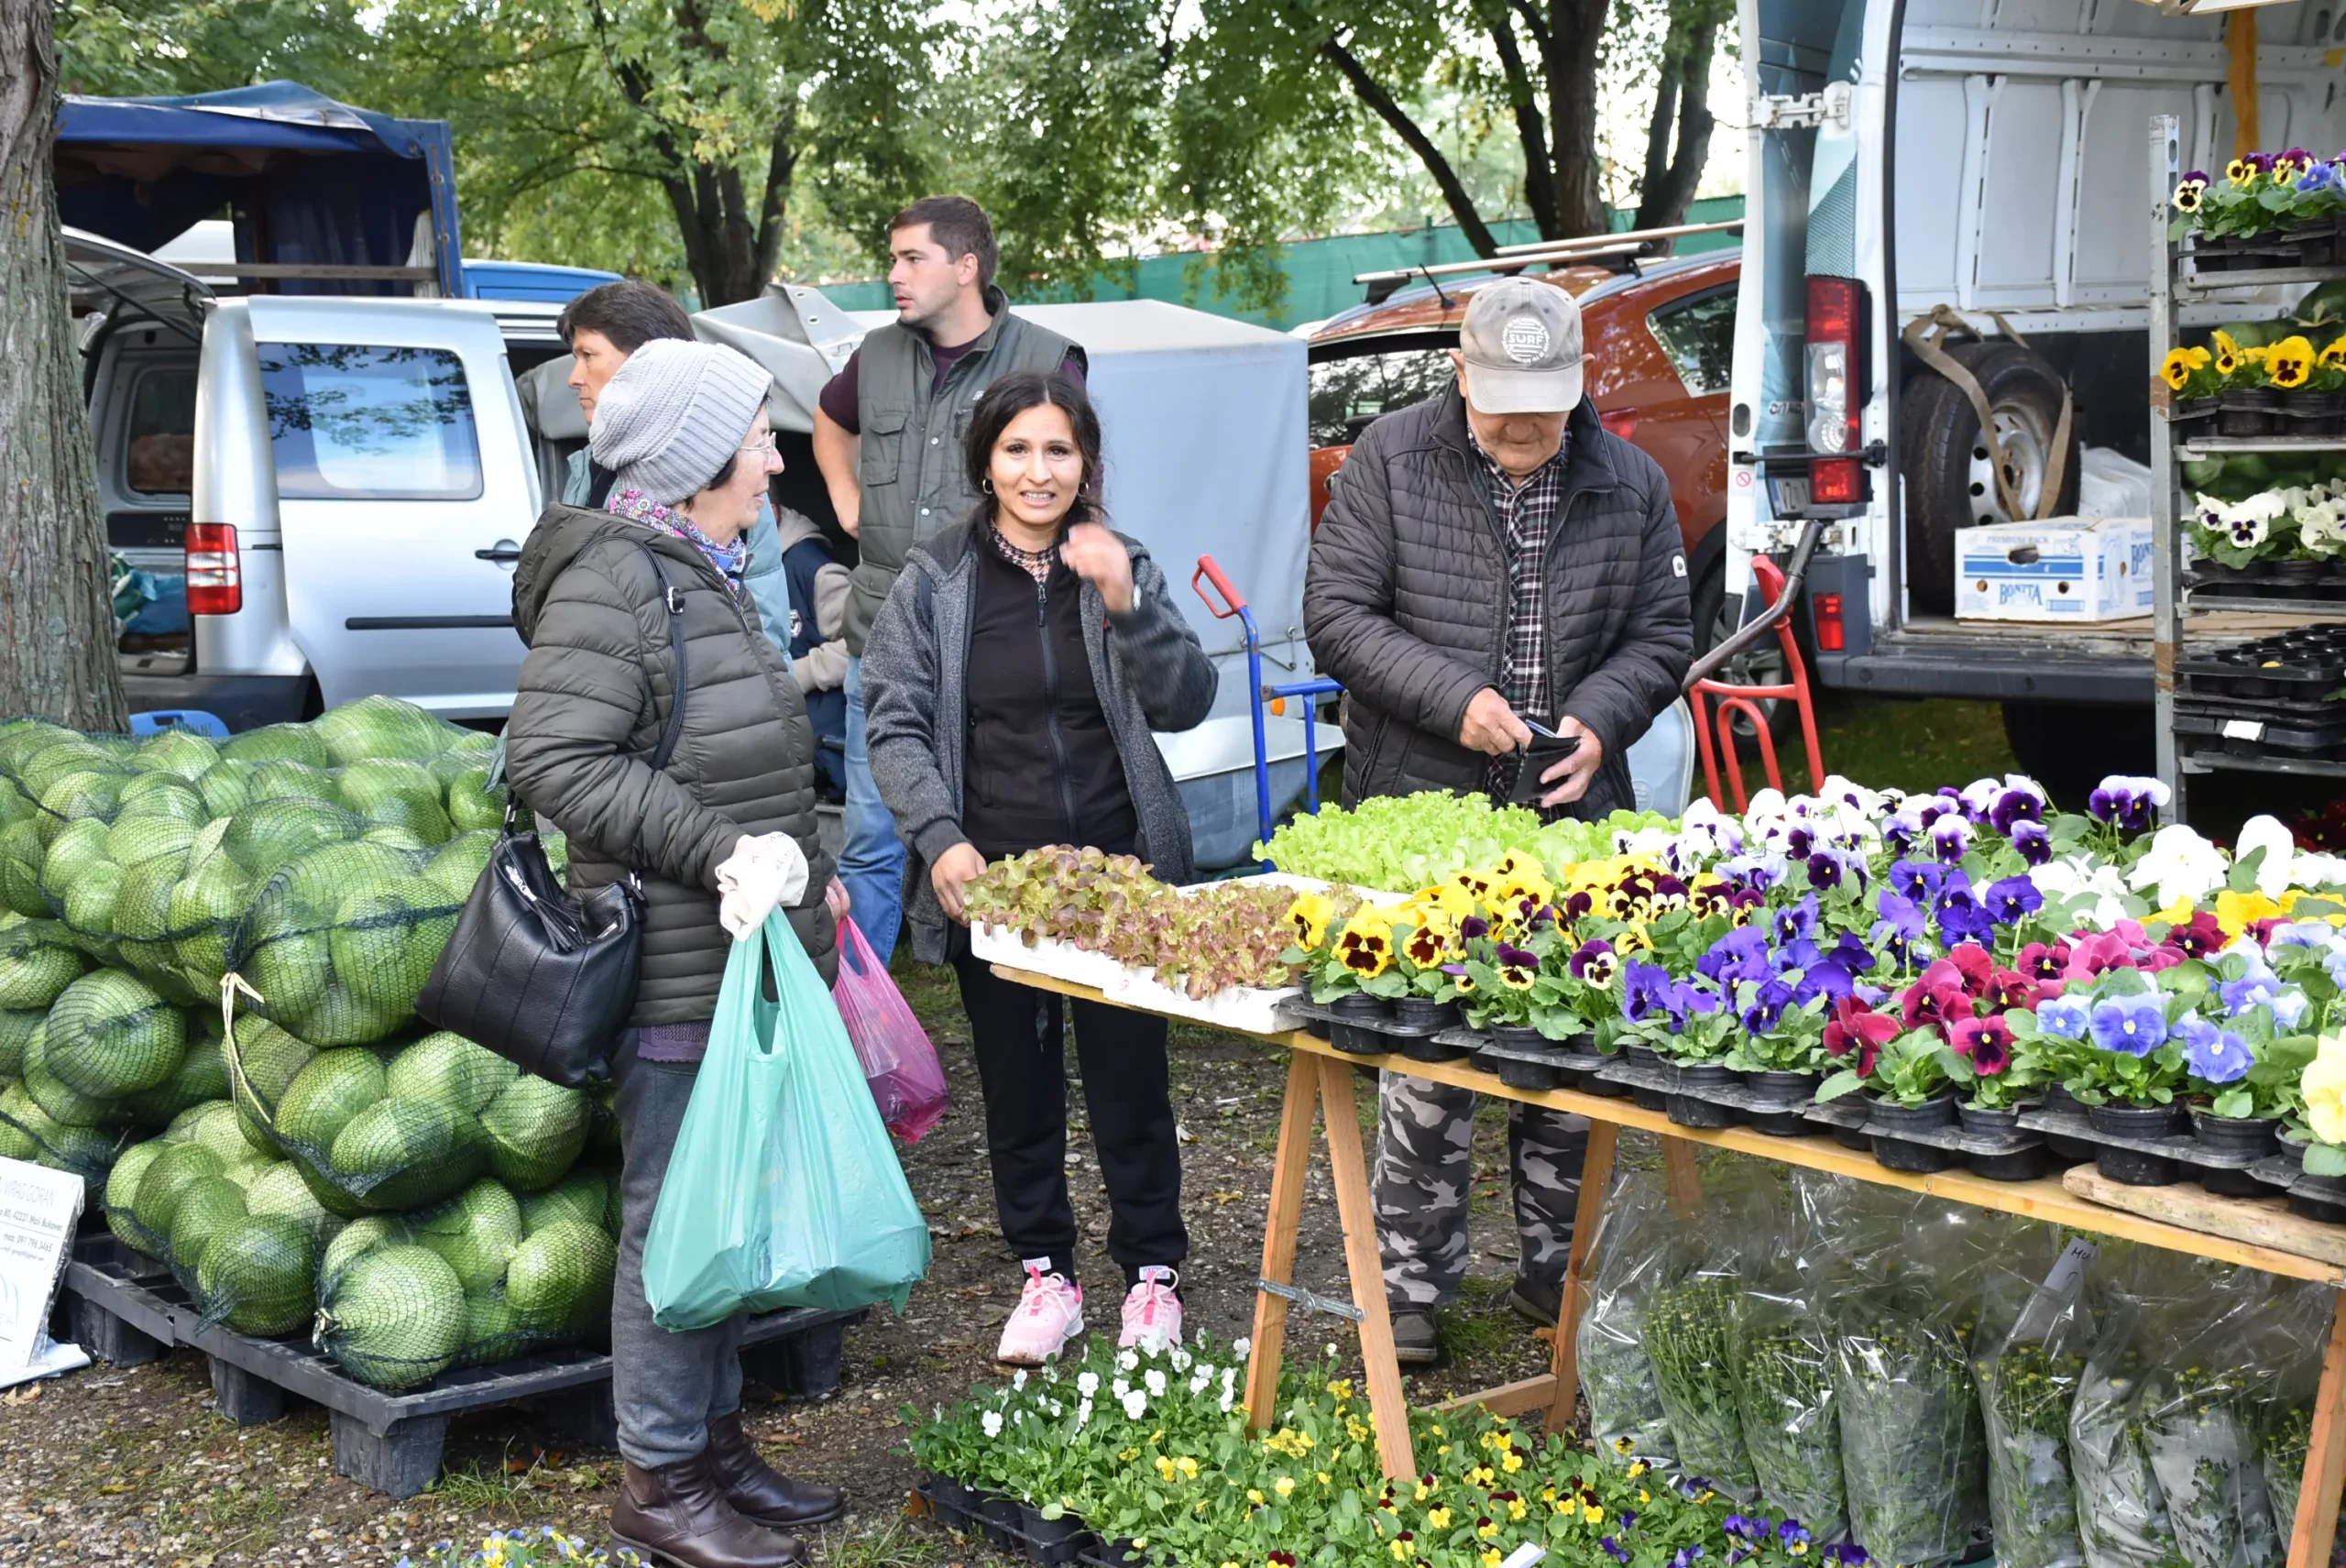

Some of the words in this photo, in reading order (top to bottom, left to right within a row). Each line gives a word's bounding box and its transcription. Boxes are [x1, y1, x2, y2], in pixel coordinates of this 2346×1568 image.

[1508, 334, 1544, 345] SURF
[2131, 543, 2154, 576] BON
[1999, 584, 2043, 606] BONITA
[27, 1184, 54, 1206] GORAN
[41, 1218, 63, 1232] Bukovec
